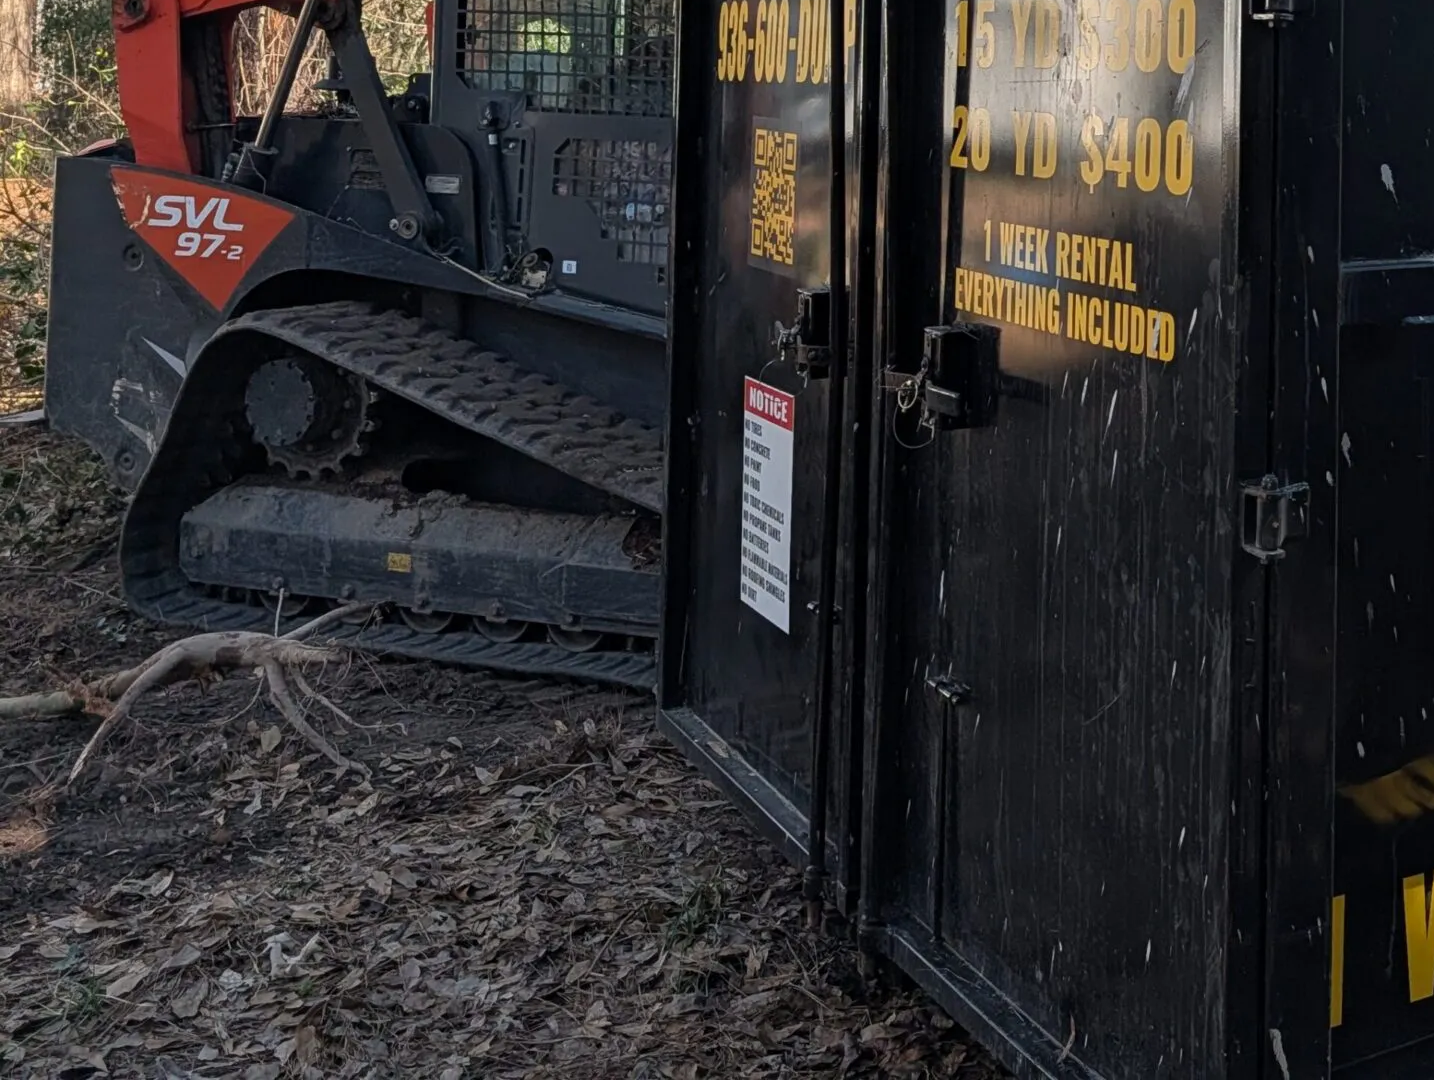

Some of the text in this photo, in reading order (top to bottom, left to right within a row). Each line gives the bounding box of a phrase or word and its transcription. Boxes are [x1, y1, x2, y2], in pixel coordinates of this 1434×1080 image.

[954, 0, 996, 70] 15
[950, 104, 1194, 196] 20 YD $400
[147, 194, 244, 232] SVL
[174, 231, 244, 260] 97-2
[983, 219, 1137, 293] 1 WEEK RENTAL
[954, 266, 1176, 363] EVERYTHING INCLUDED
[749, 385, 788, 423] NOTICE
